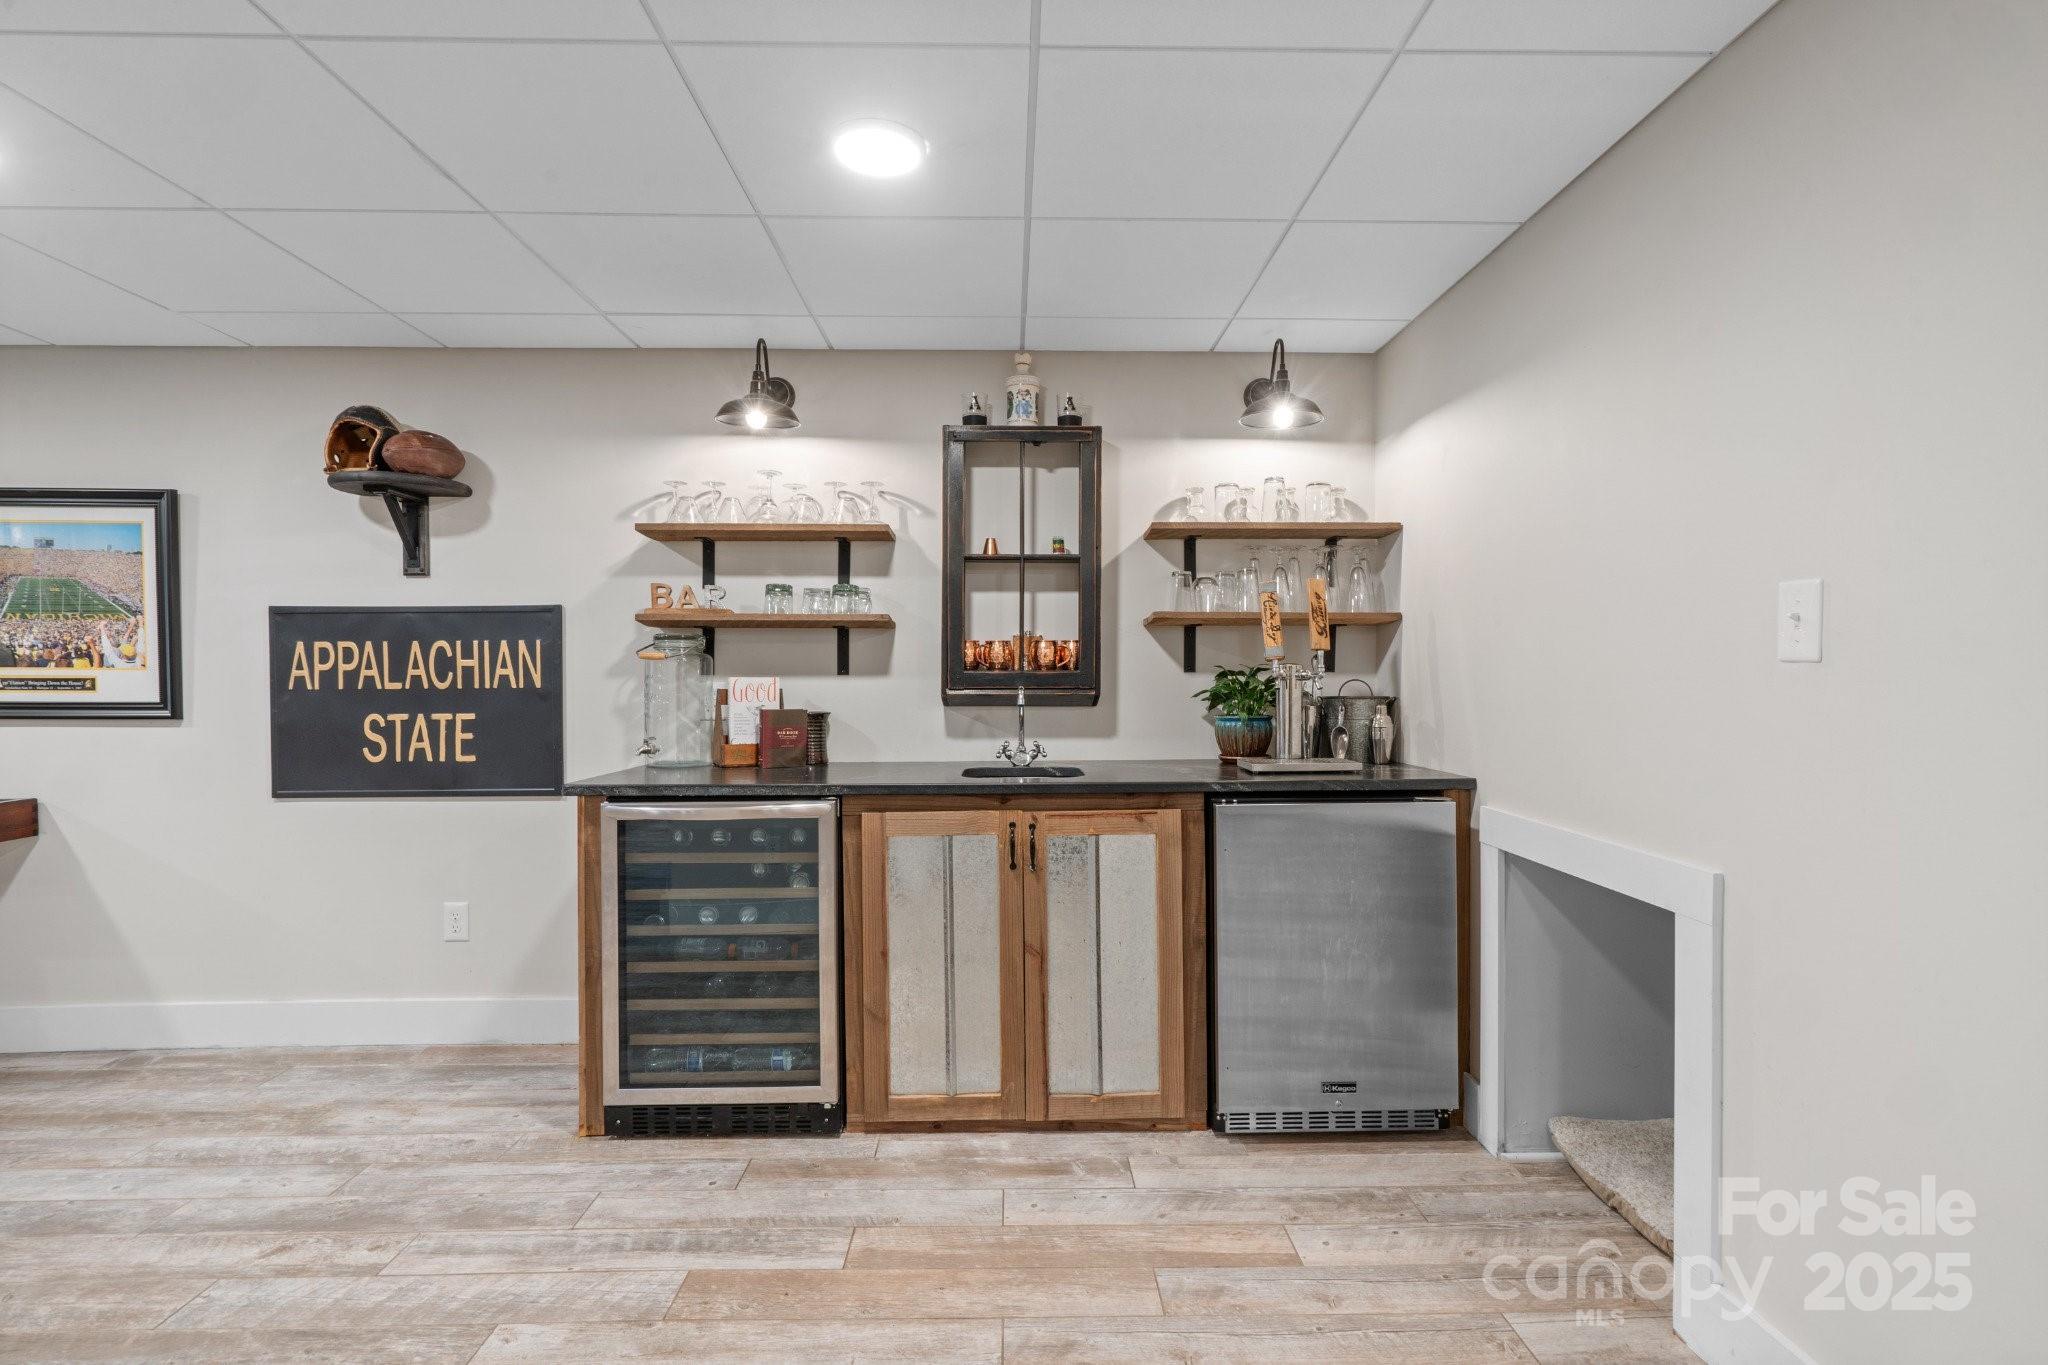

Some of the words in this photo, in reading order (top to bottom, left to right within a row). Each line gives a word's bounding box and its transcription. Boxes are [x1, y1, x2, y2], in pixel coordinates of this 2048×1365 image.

[650, 582, 727, 609] BAR
[288, 640, 542, 690] APPALACHIAN
[363, 713, 476, 763] STATE
